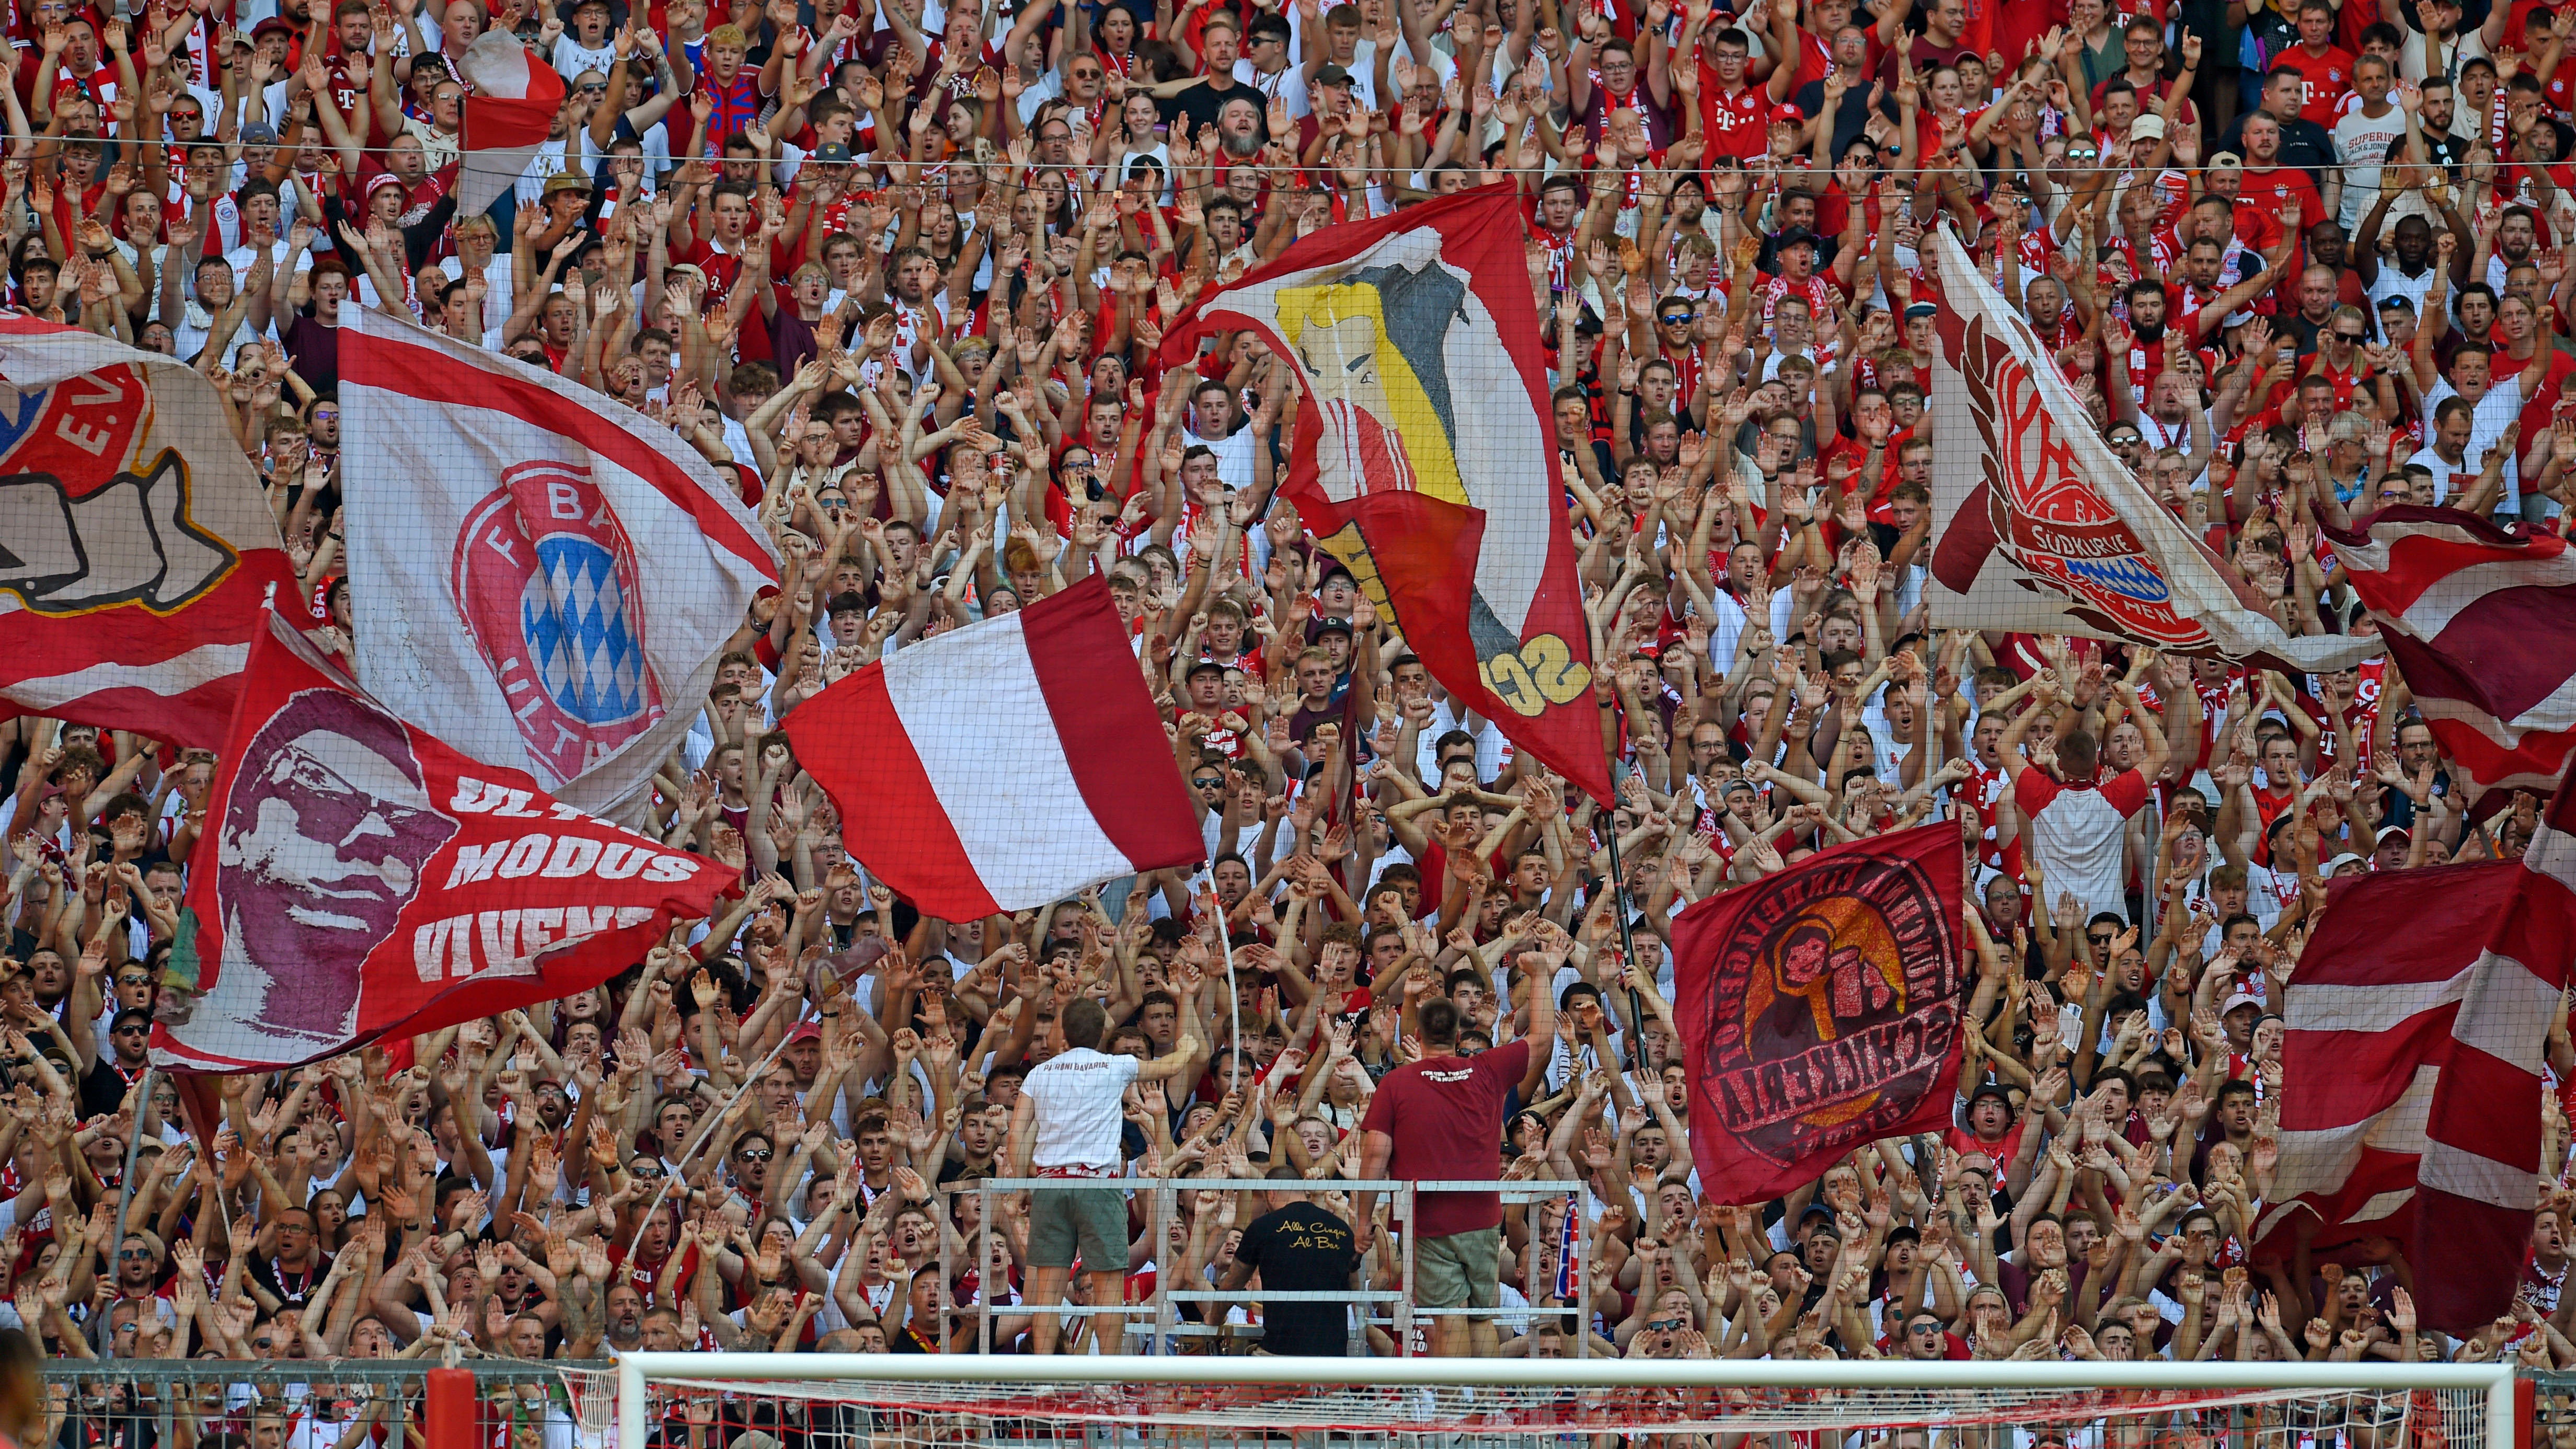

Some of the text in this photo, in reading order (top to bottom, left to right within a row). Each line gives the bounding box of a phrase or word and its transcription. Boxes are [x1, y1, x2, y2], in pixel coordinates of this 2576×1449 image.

[2031, 525, 2133, 558] SÜDKURVE
[442, 833, 700, 890] MODUS
[1043, 1062, 1073, 1072] PARONI
[1276, 1220, 1305, 1234] Alle
[1289, 1235, 1340, 1250] Al Bar
